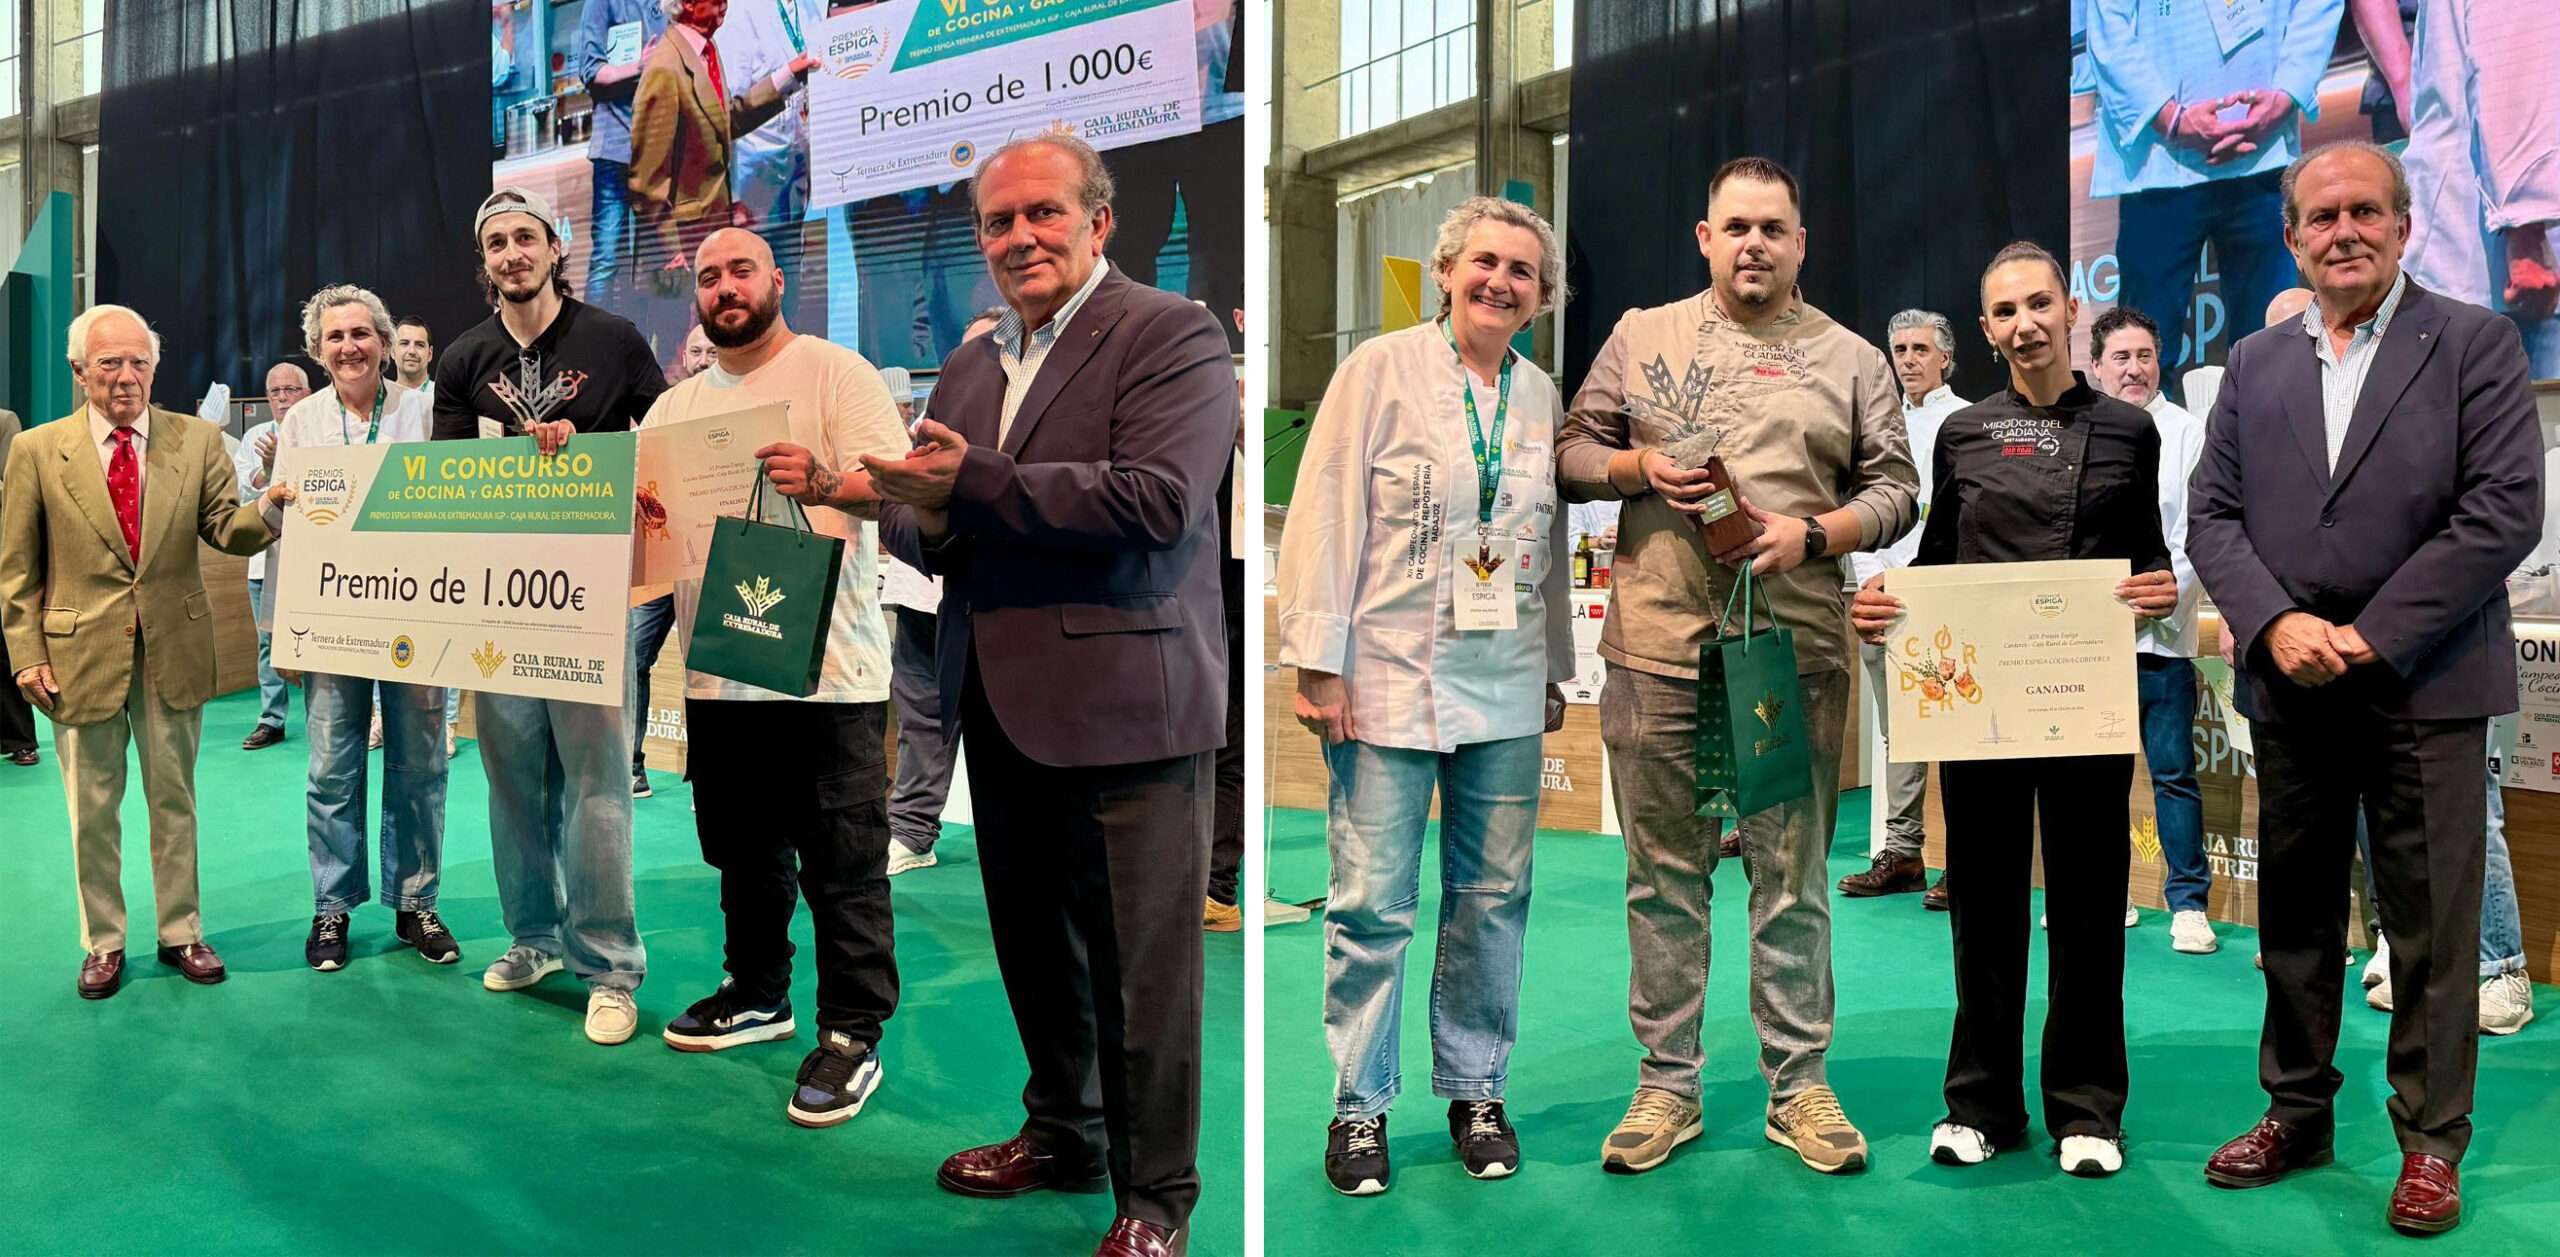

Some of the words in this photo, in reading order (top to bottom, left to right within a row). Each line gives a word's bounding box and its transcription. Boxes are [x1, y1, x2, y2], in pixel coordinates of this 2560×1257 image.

[928, 27, 941, 37] DE
[945, 4, 1014, 32] COCINA
[832, 25, 874, 43] PREMIOS
[829, 34, 878, 56] ESPIGA
[861, 88, 971, 135] Premio
[985, 73, 1024, 104] de
[1045, 43, 1153, 92] 1.000€
[1115, 106, 1156, 122] RURAL
[1163, 100, 1181, 112] DE
[1084, 111, 1181, 138] EXTREMADURA
[856, 166, 885, 177] Ternera
[886, 161, 896, 171] de
[897, 150, 949, 169] Extremadura
[1991, 427, 2057, 440] GUADIANA
[2041, 419, 2064, 429] DEL
[307, 468, 344, 478] PREMIOS
[403, 455, 426, 481] VI
[440, 453, 593, 480] CONCURSO
[303, 479, 346, 492] ESPIGA
[1412, 463, 1421, 498] ESPAÑA
[388, 490, 400, 500] DE
[404, 484, 465, 500] COCINA
[481, 482, 614, 499] GASTRONOMIA
[1422, 464, 1432, 521] REPOSTERÍA
[1413, 499, 1421, 509] DE
[412, 511, 437, 520] TERNERA
[438, 511, 447, 520] DE
[448, 511, 494, 520] EXTREMADURA
[510, 511, 526, 521] CAJA
[528, 511, 549, 520] RURAL
[551, 511, 561, 520] DE
[1431, 503, 1441, 543] BADAJOZ
[1408, 511, 1420, 567] CAMPEONATO
[1418, 530, 1429, 565] COCINA
[1416, 567, 1425, 580] DE
[319, 562, 418, 602] Premio
[430, 566, 465, 604] de
[483, 567, 586, 611] 1.000€
[1472, 592, 1497, 600] ESPIGA
[2034, 598, 2063, 606] ESPIGA
[722, 619, 783, 640] EXTREMADURA
[724, 613, 741, 622] CAJA
[742, 616, 768, 629] RURAL
[769, 623, 780, 632] DE
[311, 632, 335, 645] Ternera
[336, 634, 345, 646] de
[346, 634, 390, 650] Extremadura
[513, 653, 541, 666] CAJA
[543, 656, 582, 670] RURAL
[588, 660, 605, 672] DE
[512, 665, 604, 685] EXTREMADURA
[2025, 683, 2086, 696] GANADOR
[660, 708, 681, 725] DE
[1543, 757, 1566, 774] DE
